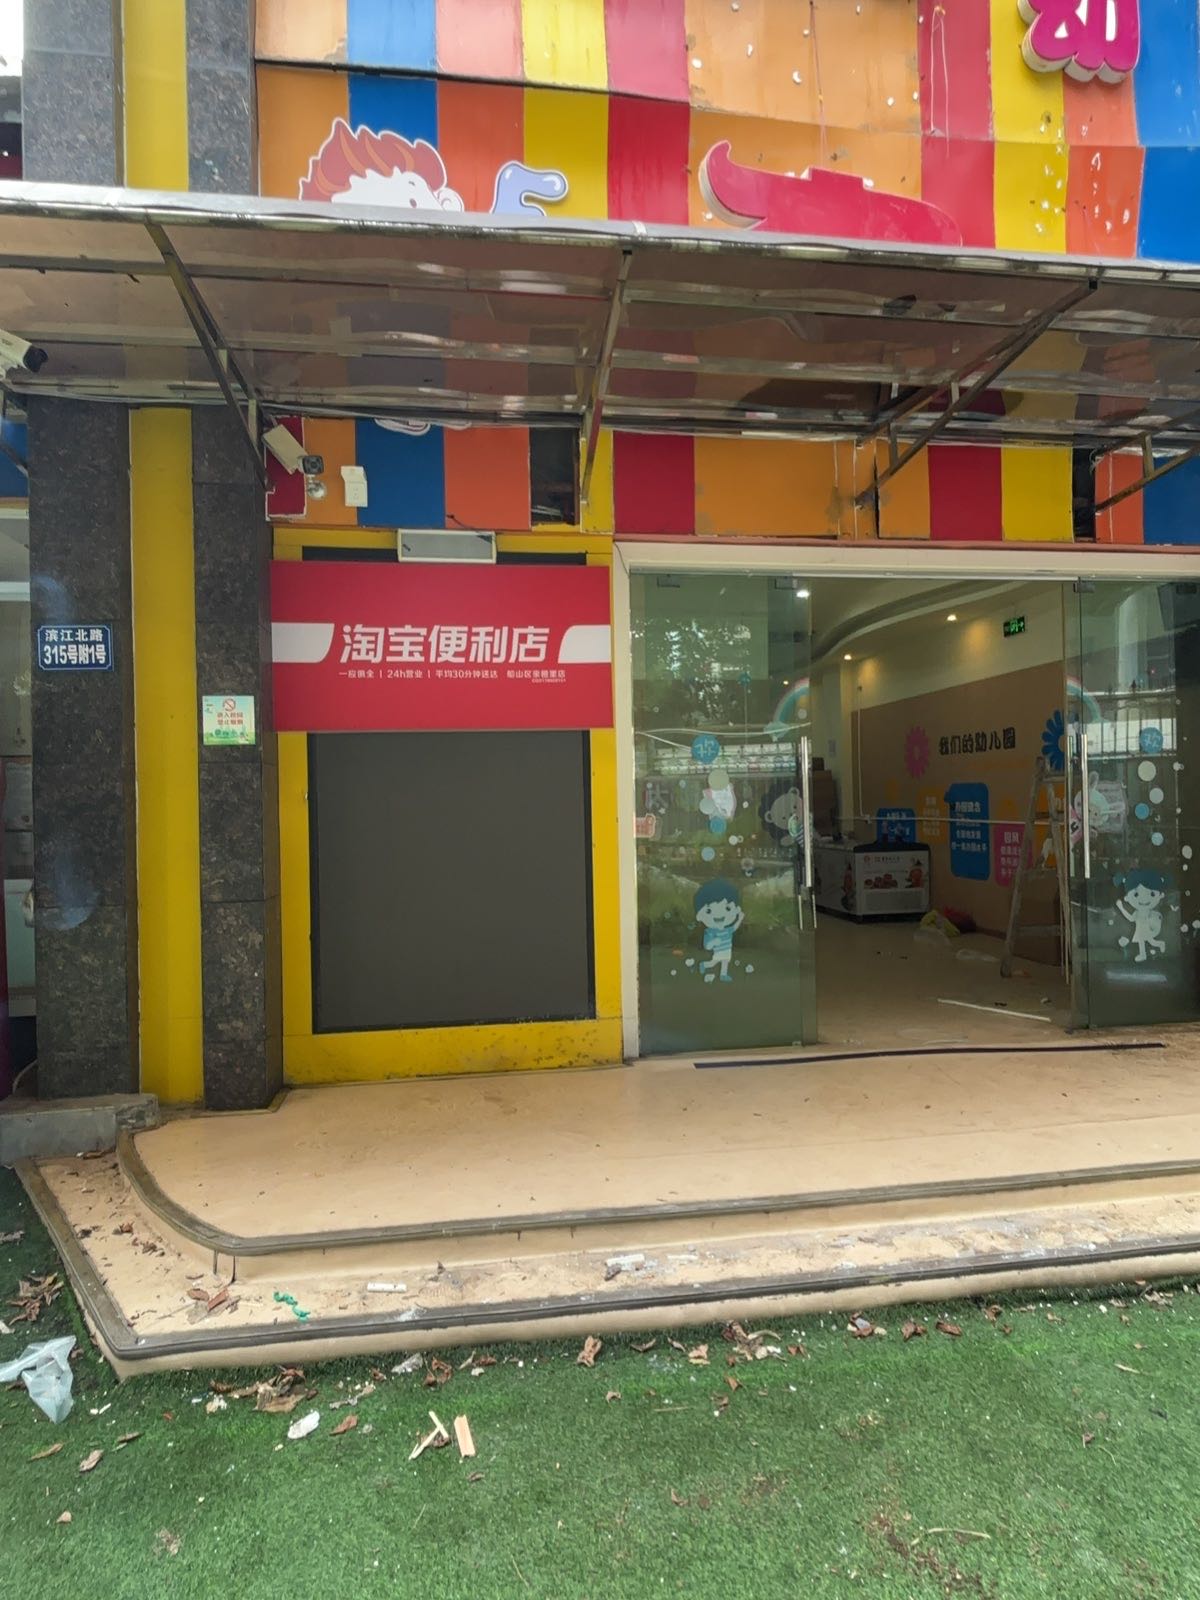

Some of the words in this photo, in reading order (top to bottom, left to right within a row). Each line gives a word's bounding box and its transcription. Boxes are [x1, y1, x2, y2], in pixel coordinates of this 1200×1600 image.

[44, 628, 103, 642] 滨江北路
[339, 623, 550, 663] 淘宝便利店
[43, 643, 106, 665] 315号附1号
[338, 668, 374, 679] 一应俱全
[387, 668, 423, 679] 24h营业
[435, 669, 498, 679] 平均30分钟送达
[939, 727, 1016, 756] 我们的幼儿园
